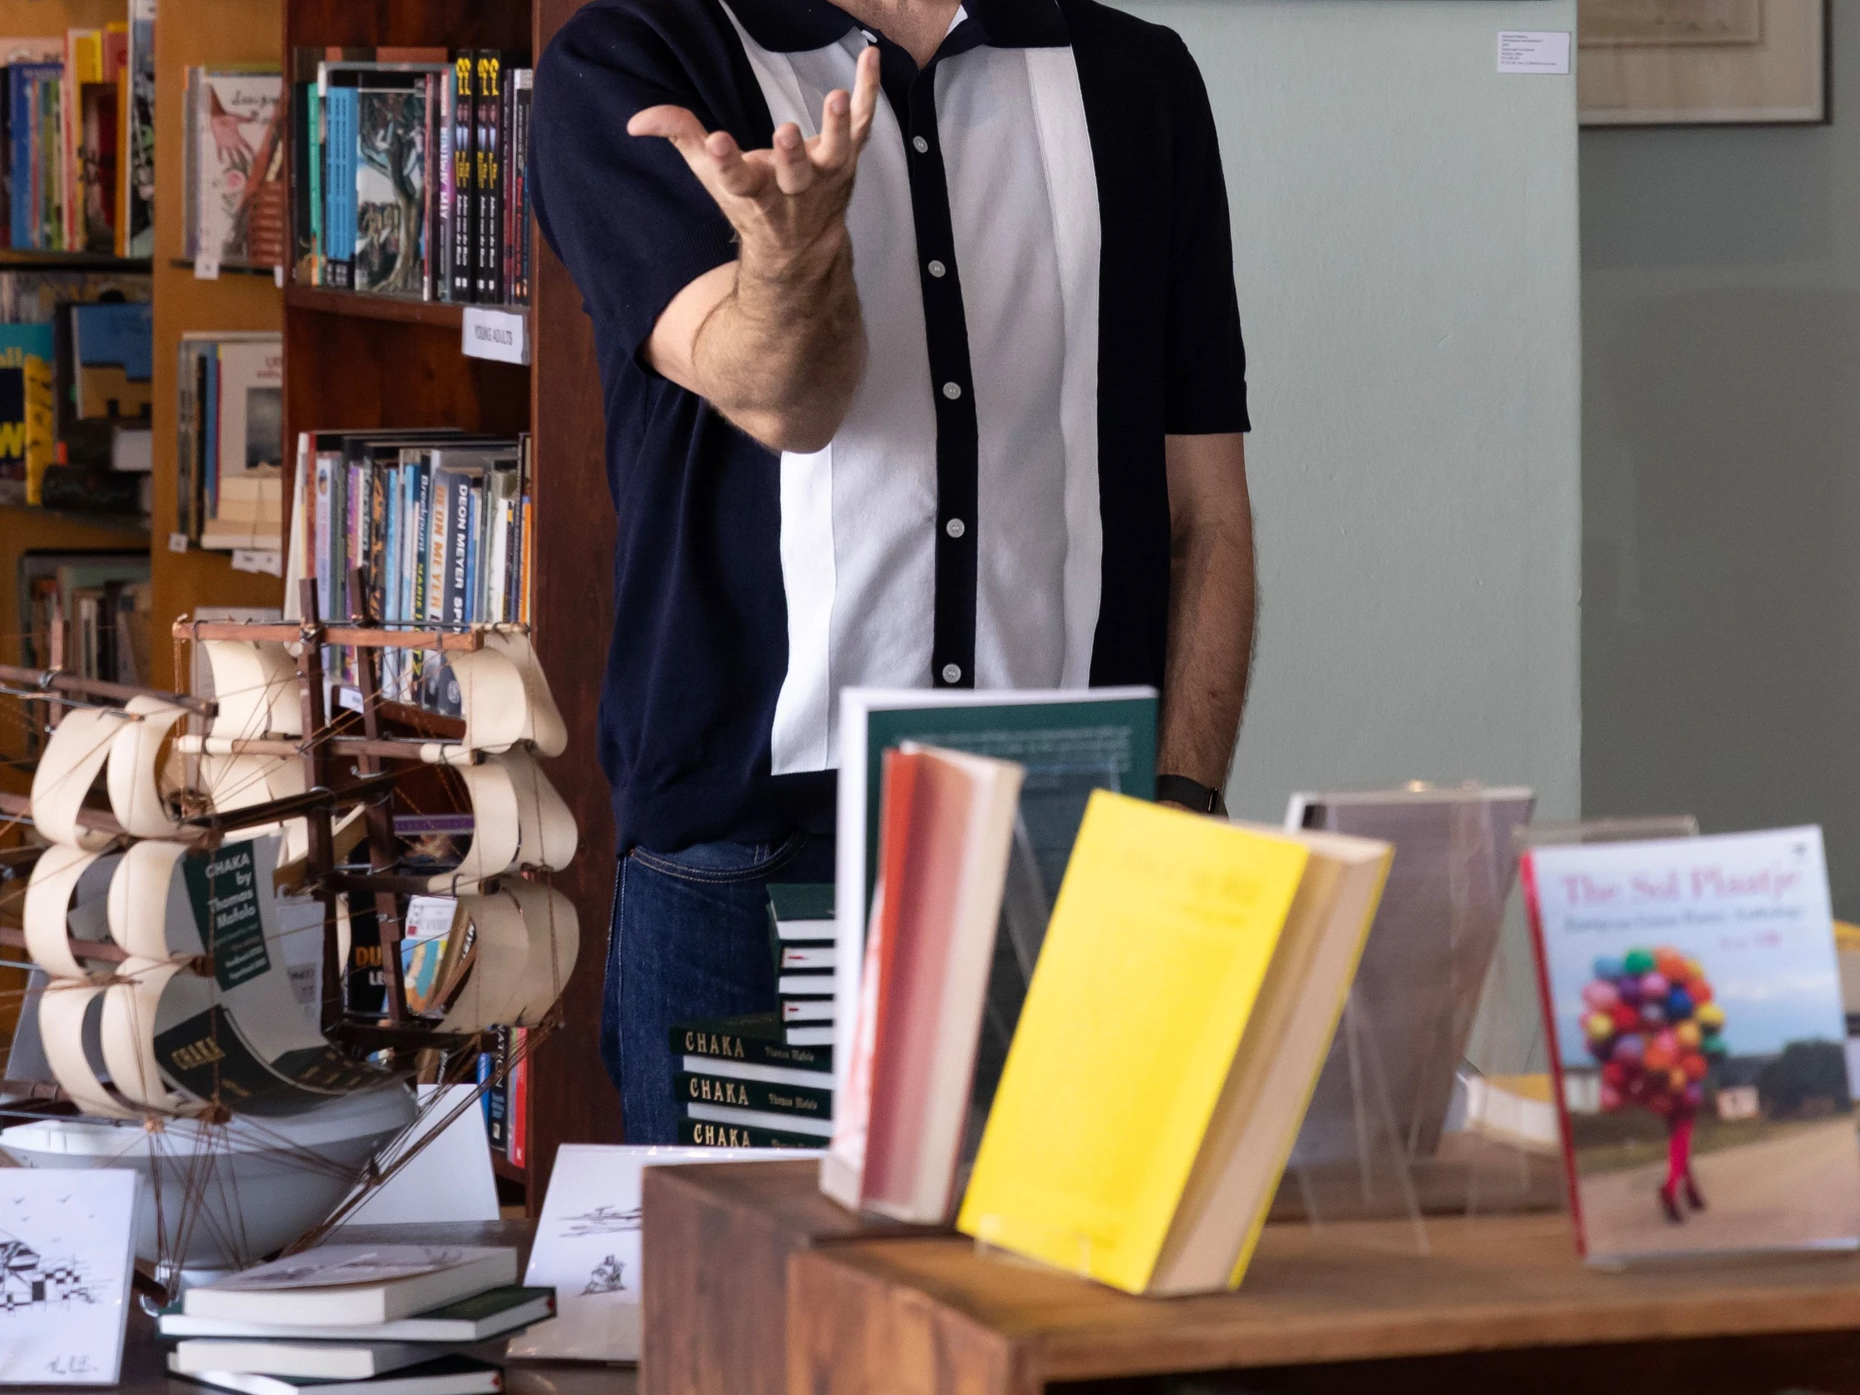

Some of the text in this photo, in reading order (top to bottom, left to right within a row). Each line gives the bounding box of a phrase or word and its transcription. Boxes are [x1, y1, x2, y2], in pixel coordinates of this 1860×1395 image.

[453, 484, 468, 635] DEON MEYER SPO
[205, 852, 251, 879] CHAKA
[235, 871, 252, 888] by
[207, 888, 254, 914] Thomas
[685, 1031, 745, 1059] CHAKA
[689, 1077, 749, 1106] CHAKA
[693, 1123, 751, 1148] CHAKA
